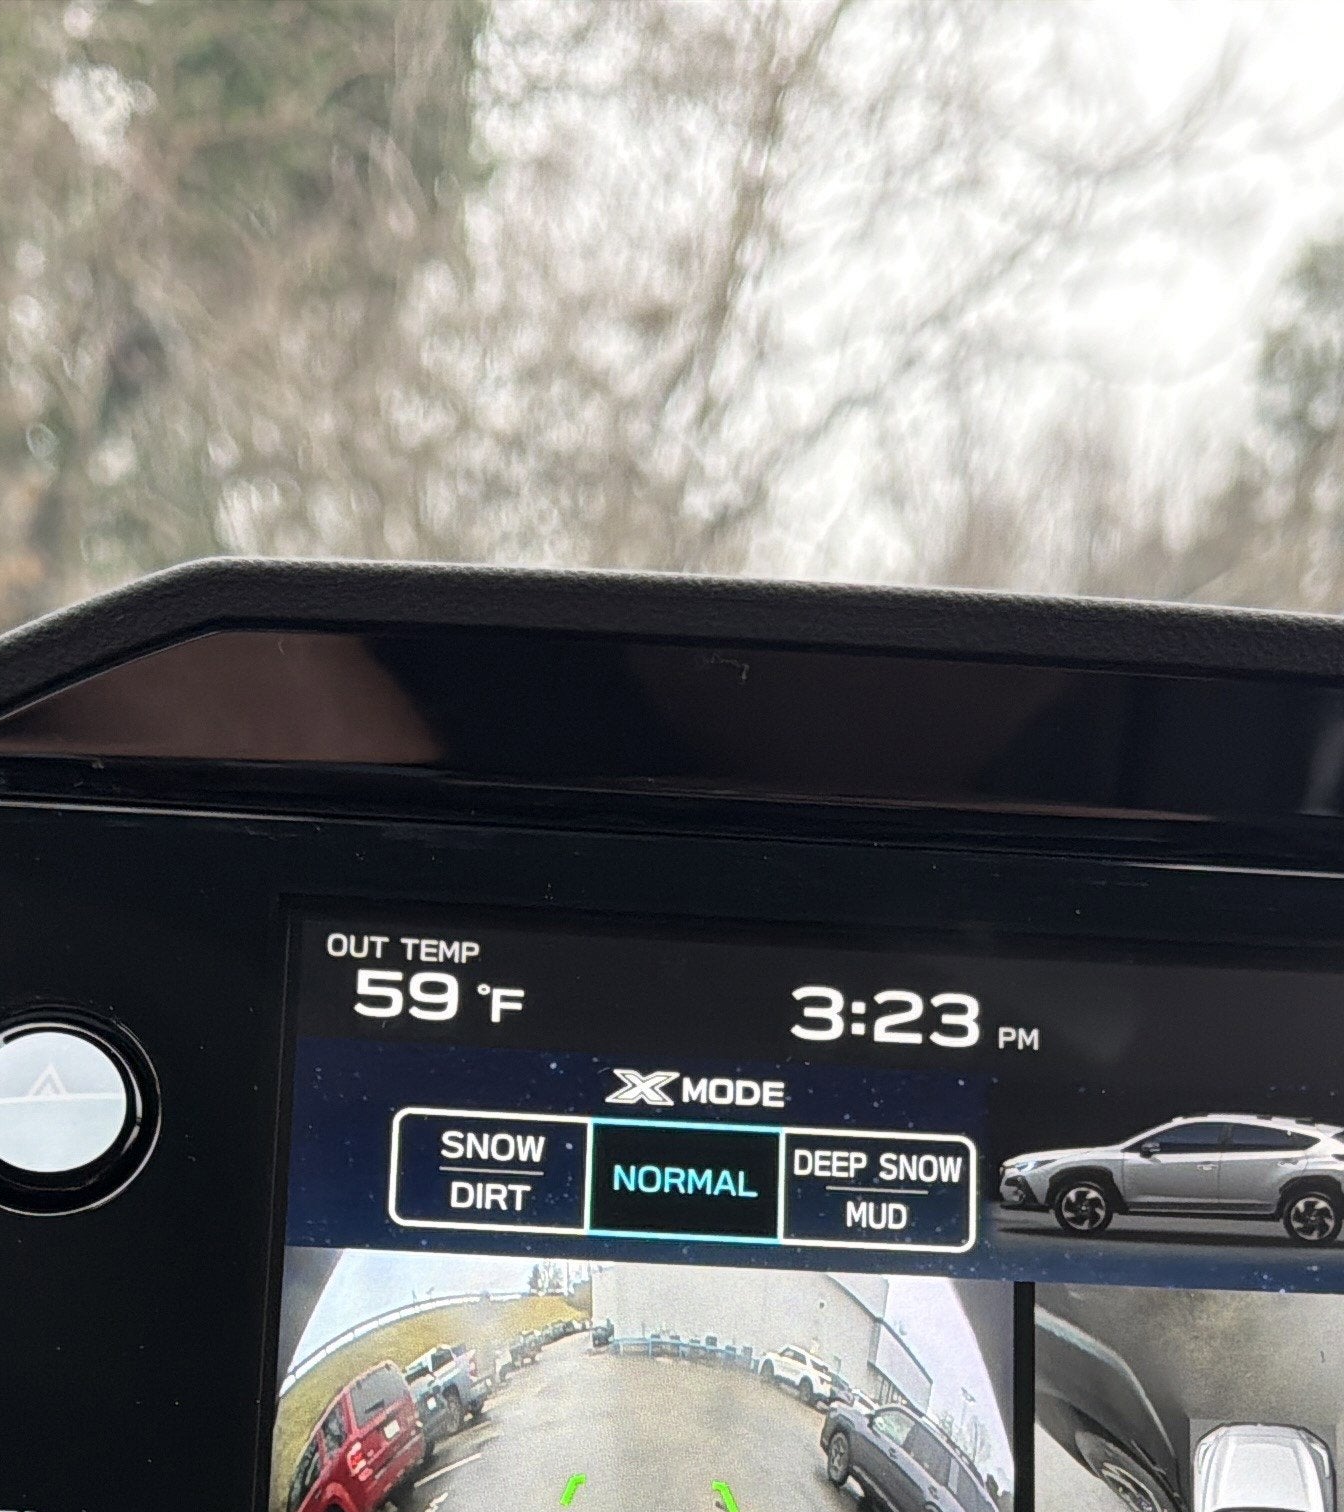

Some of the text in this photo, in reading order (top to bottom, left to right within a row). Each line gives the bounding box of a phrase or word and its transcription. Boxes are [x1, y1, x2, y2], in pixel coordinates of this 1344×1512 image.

[327, 934, 480, 963] OUT TEMP
[354, 969, 460, 1022] 59
[791, 986, 1040, 1050] 3:23 PM
[682, 1077, 785, 1108] MODE
[440, 1130, 546, 1164] SNOW
[613, 1165, 758, 1198] NORMAL
[793, 1149, 963, 1184] DEEP SNOW
[450, 1181, 531, 1212] DIRT
[846, 1203, 907, 1230] MUD
